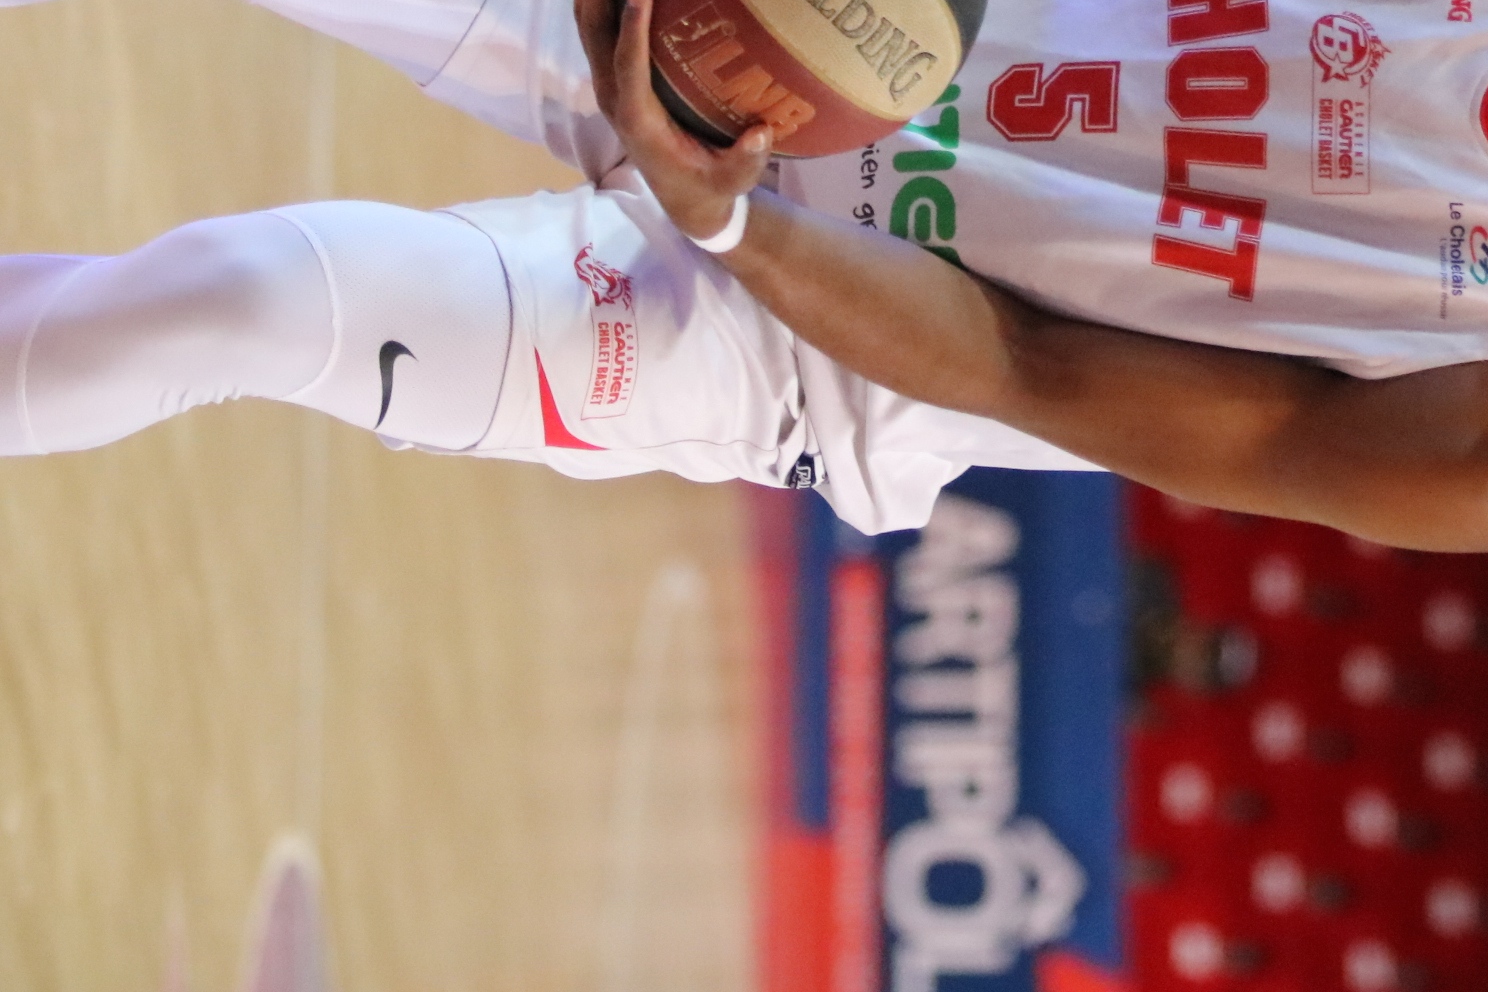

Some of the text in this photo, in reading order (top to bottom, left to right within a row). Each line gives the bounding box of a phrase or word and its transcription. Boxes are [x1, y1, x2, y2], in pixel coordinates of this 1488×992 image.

[986, 61, 1121, 142] 5
[1318, 98, 1333, 180] CHOLET BASKET
[1338, 99, 1353, 179] GAUTIER
[860, 143, 879, 189] ien
[1449, 202, 1466, 296] Le Choletais
[589, 322, 610, 406] CHOLET BASKET
[607, 322, 626, 405] GAUTIER
